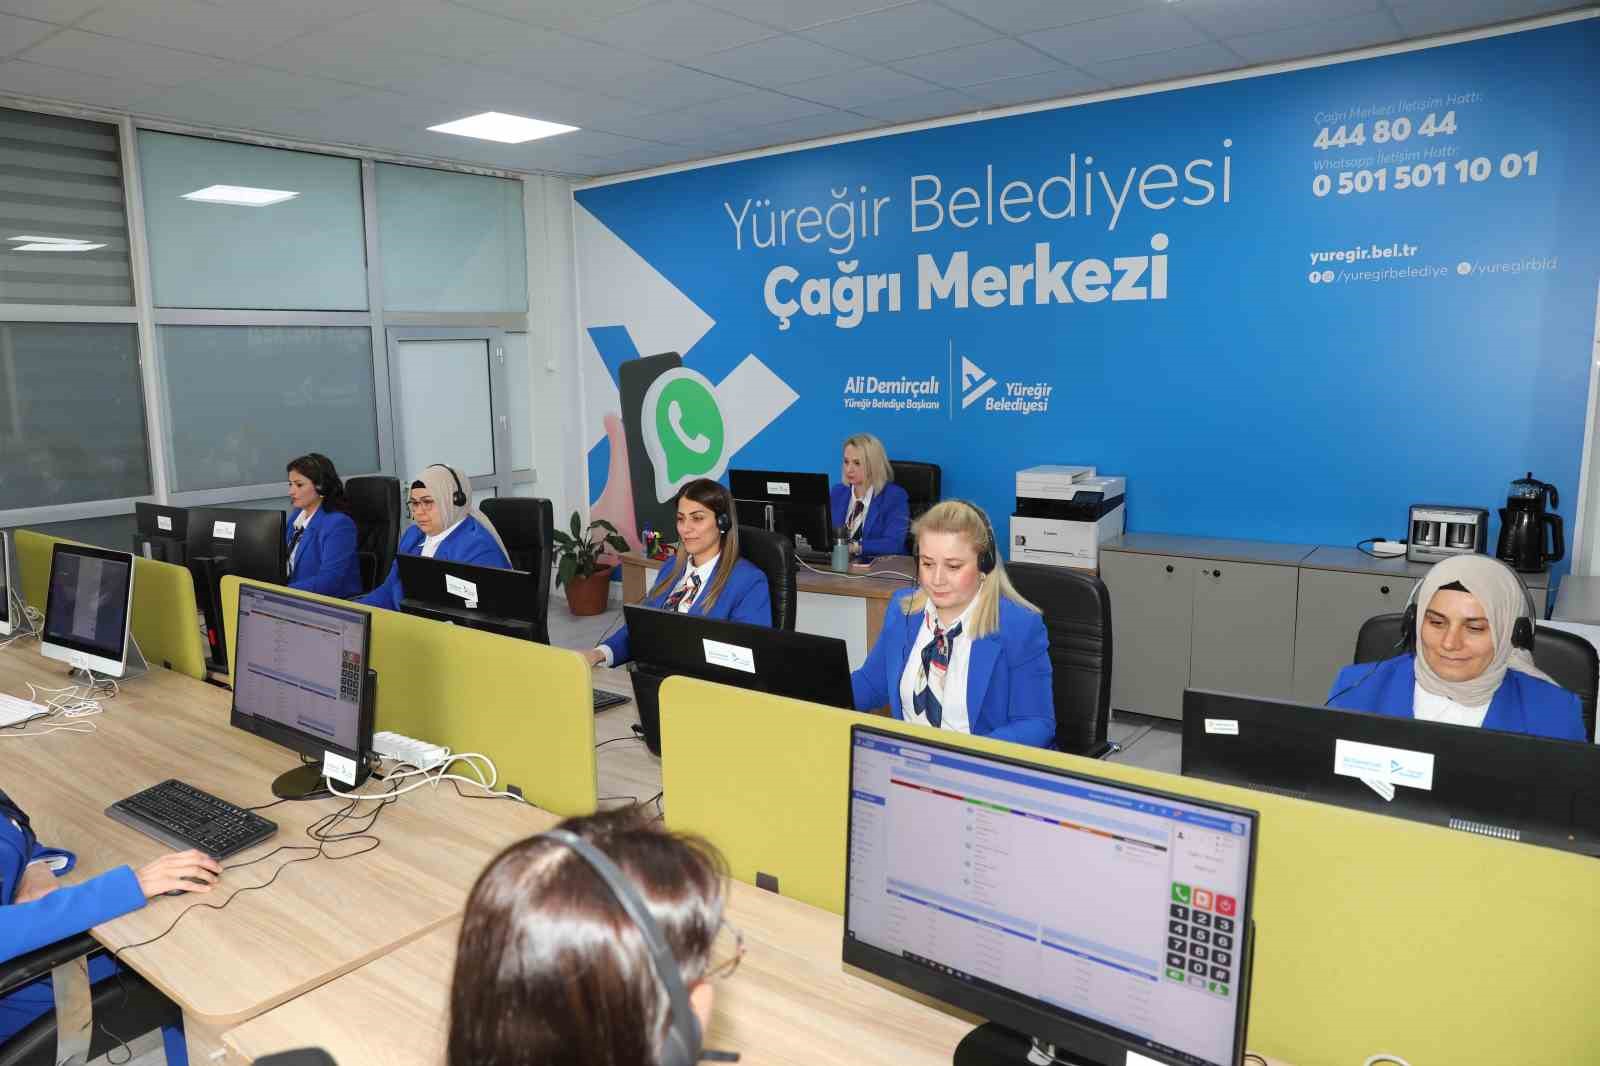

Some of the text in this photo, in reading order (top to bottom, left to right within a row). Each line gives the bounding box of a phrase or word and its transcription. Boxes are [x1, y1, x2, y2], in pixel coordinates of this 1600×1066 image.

[1313, 111, 1457, 150] 444 80 44
[1312, 151, 1538, 197] 0 501 501 10 01
[1313, 157, 1372, 172] Whatsapp
[724, 138, 1233, 255] Yüreğir Belediyesi
[1310, 243, 1418, 265] yuregir.bel.tr
[763, 233, 1169, 330] Çağrı Merkezi
[844, 375, 939, 397] Ali Demirçalı
[1006, 383, 1053, 400] Yüreğir
[844, 398, 940, 411] Yüreğir Belediye Başkanı
[985, 396, 1048, 415] Belediyesi
